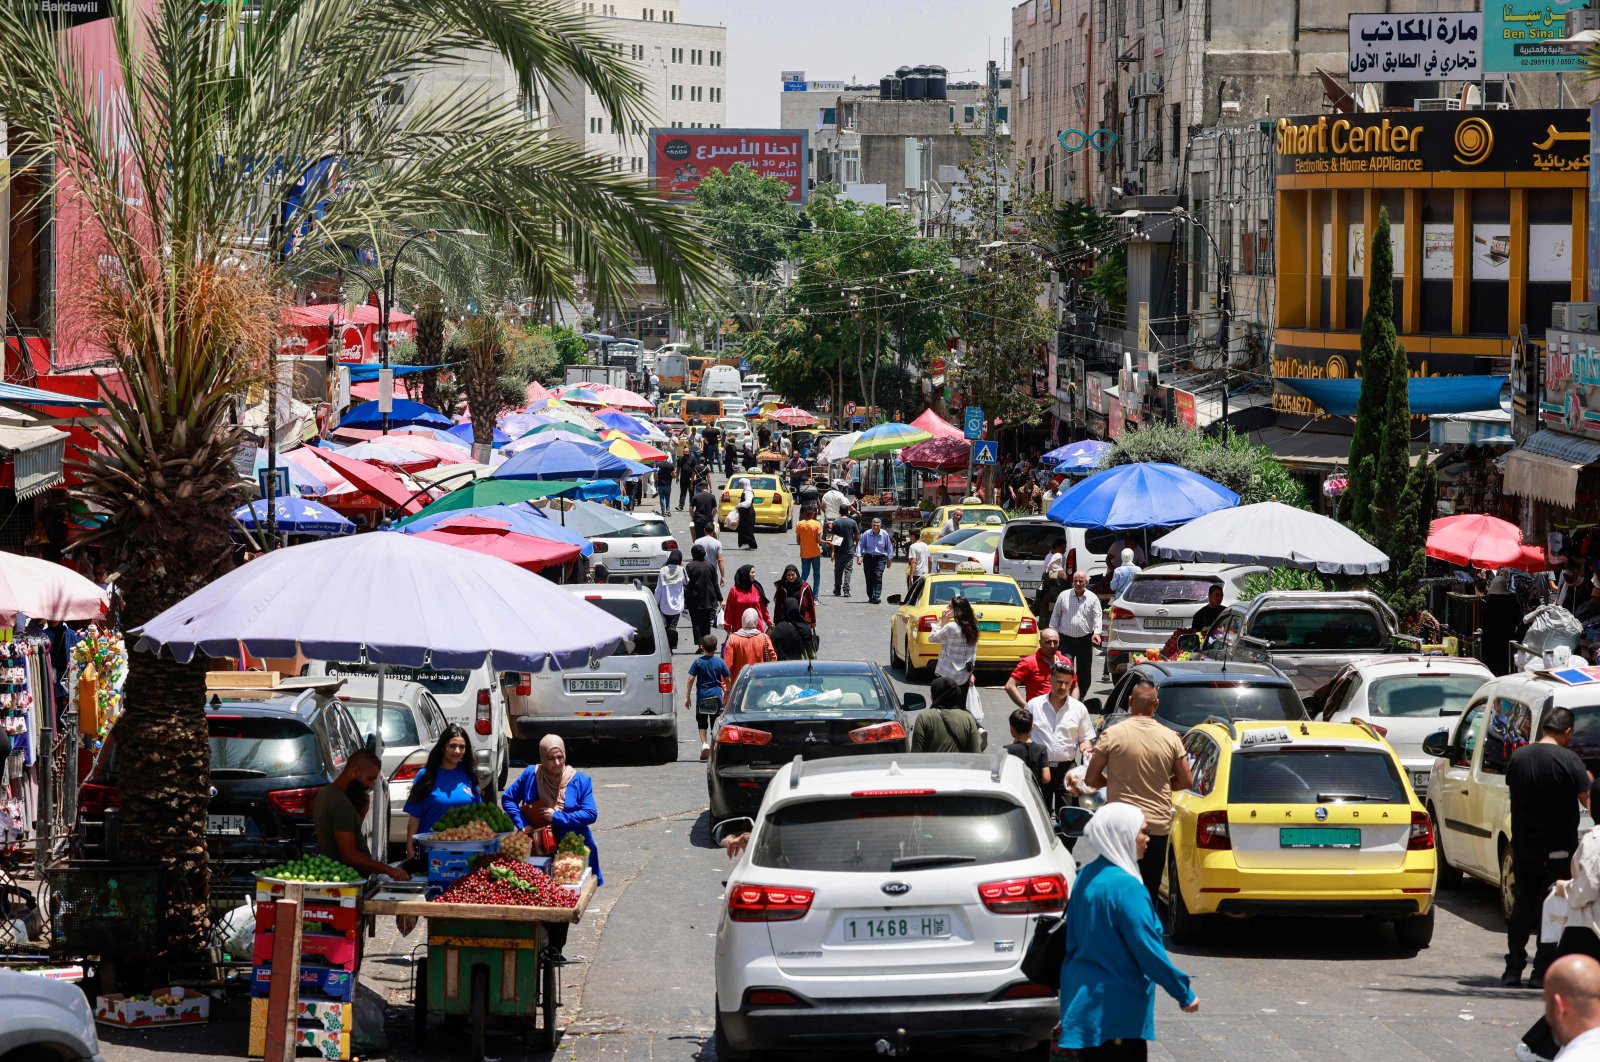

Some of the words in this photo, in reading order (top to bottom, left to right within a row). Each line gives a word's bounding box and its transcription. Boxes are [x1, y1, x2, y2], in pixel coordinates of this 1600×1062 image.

[42, 1, 98, 13] Bardawill
[1503, 4, 1541, 26] سينا
[1361, 18, 1432, 47] المكاتب
[1503, 28, 1525, 39] Ben
[1529, 28, 1554, 39] Sina
[1382, 51, 1420, 72] الطابق
[1424, 50, 1437, 77] في
[1440, 50, 1477, 77] تجاري
[1275, 116, 1329, 155] Smart
[1331, 118, 1425, 154] Center
[696, 138, 760, 160] الأسرع
[764, 142, 797, 155] احنا
[779, 159, 797, 168] حزم
[1295, 158, 1329, 173] Electronics
[1331, 157, 1338, 172] &
[1340, 157, 1367, 171] Home
[1533, 153, 1590, 171] كهربائية
[762, 167, 797, 178] الأسعار
[1291, 357, 1325, 379] Center
[1243, 735, 1258, 746] الله
[1260, 733, 1277, 743] شاء
[1278, 732, 1288, 740] ما
